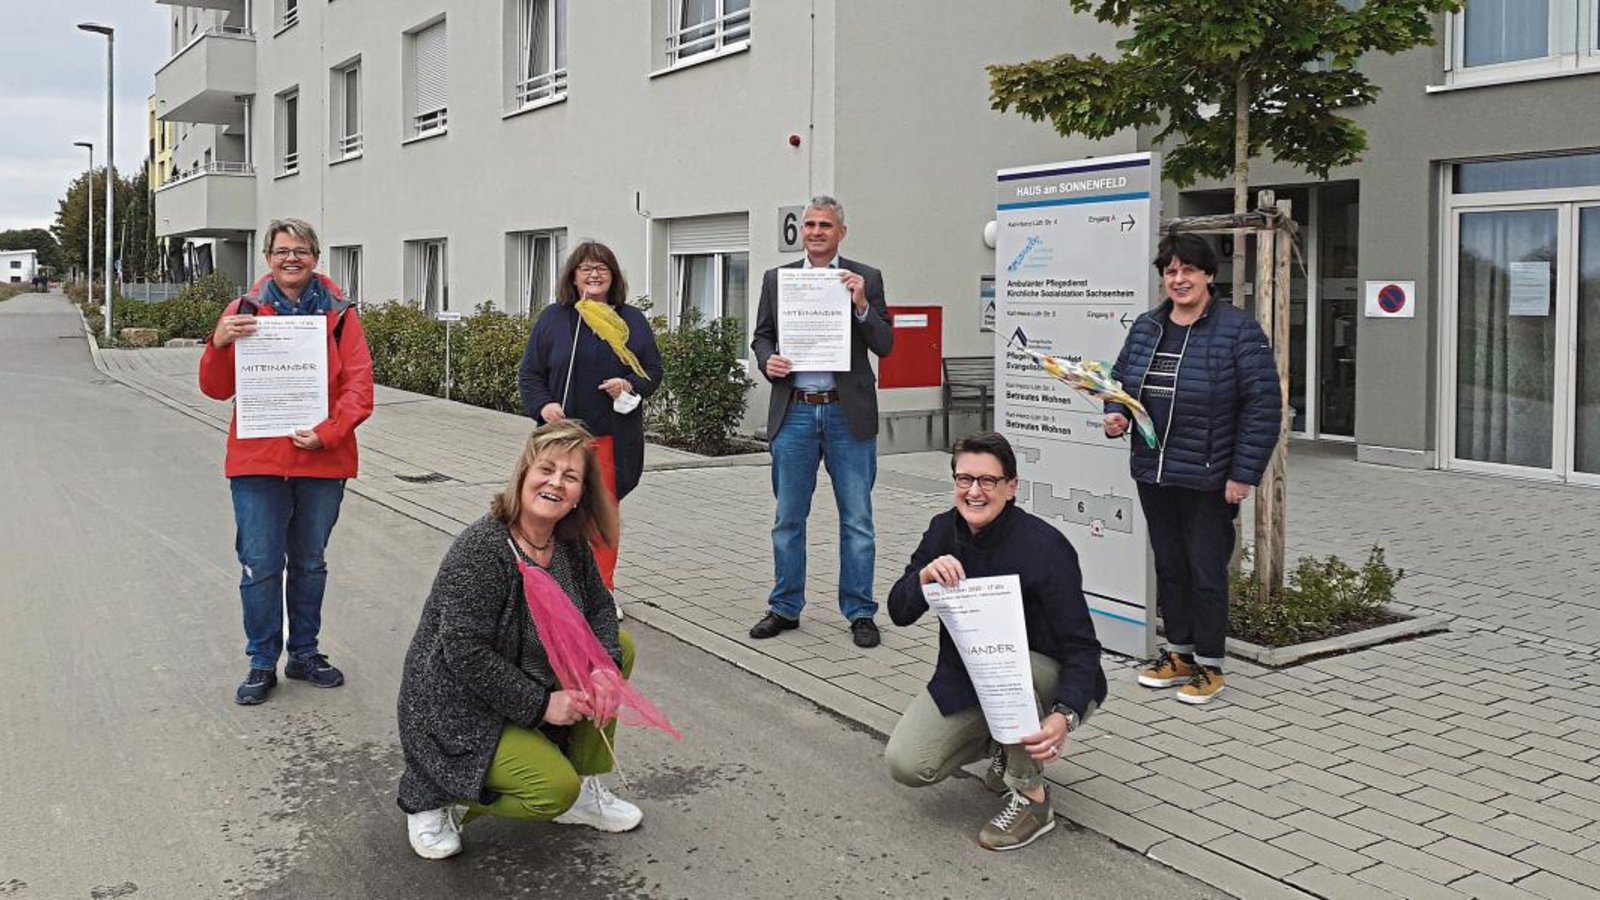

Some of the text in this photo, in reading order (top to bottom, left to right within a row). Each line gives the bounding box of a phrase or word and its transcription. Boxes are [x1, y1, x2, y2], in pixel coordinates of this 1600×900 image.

[1017, 176, 1127, 197] HAUS am SONNENFELD
[1088, 215, 1110, 224] Eingang
[784, 212, 798, 246] 6
[1007, 279, 1088, 289] Ambulanter Pflegedienst
[1007, 289, 1135, 298] Kirchliche Sozialstation Sachsenheim
[782, 309, 843, 317] MITEINANDER
[241, 363, 317, 373] MITEINANDER
[1006, 390, 1072, 405] Betreutes Wohnen
[1006, 420, 1072, 435] Betreutes Wohnen
[1077, 501, 1085, 513] 6
[1115, 508, 1123, 520] 4
